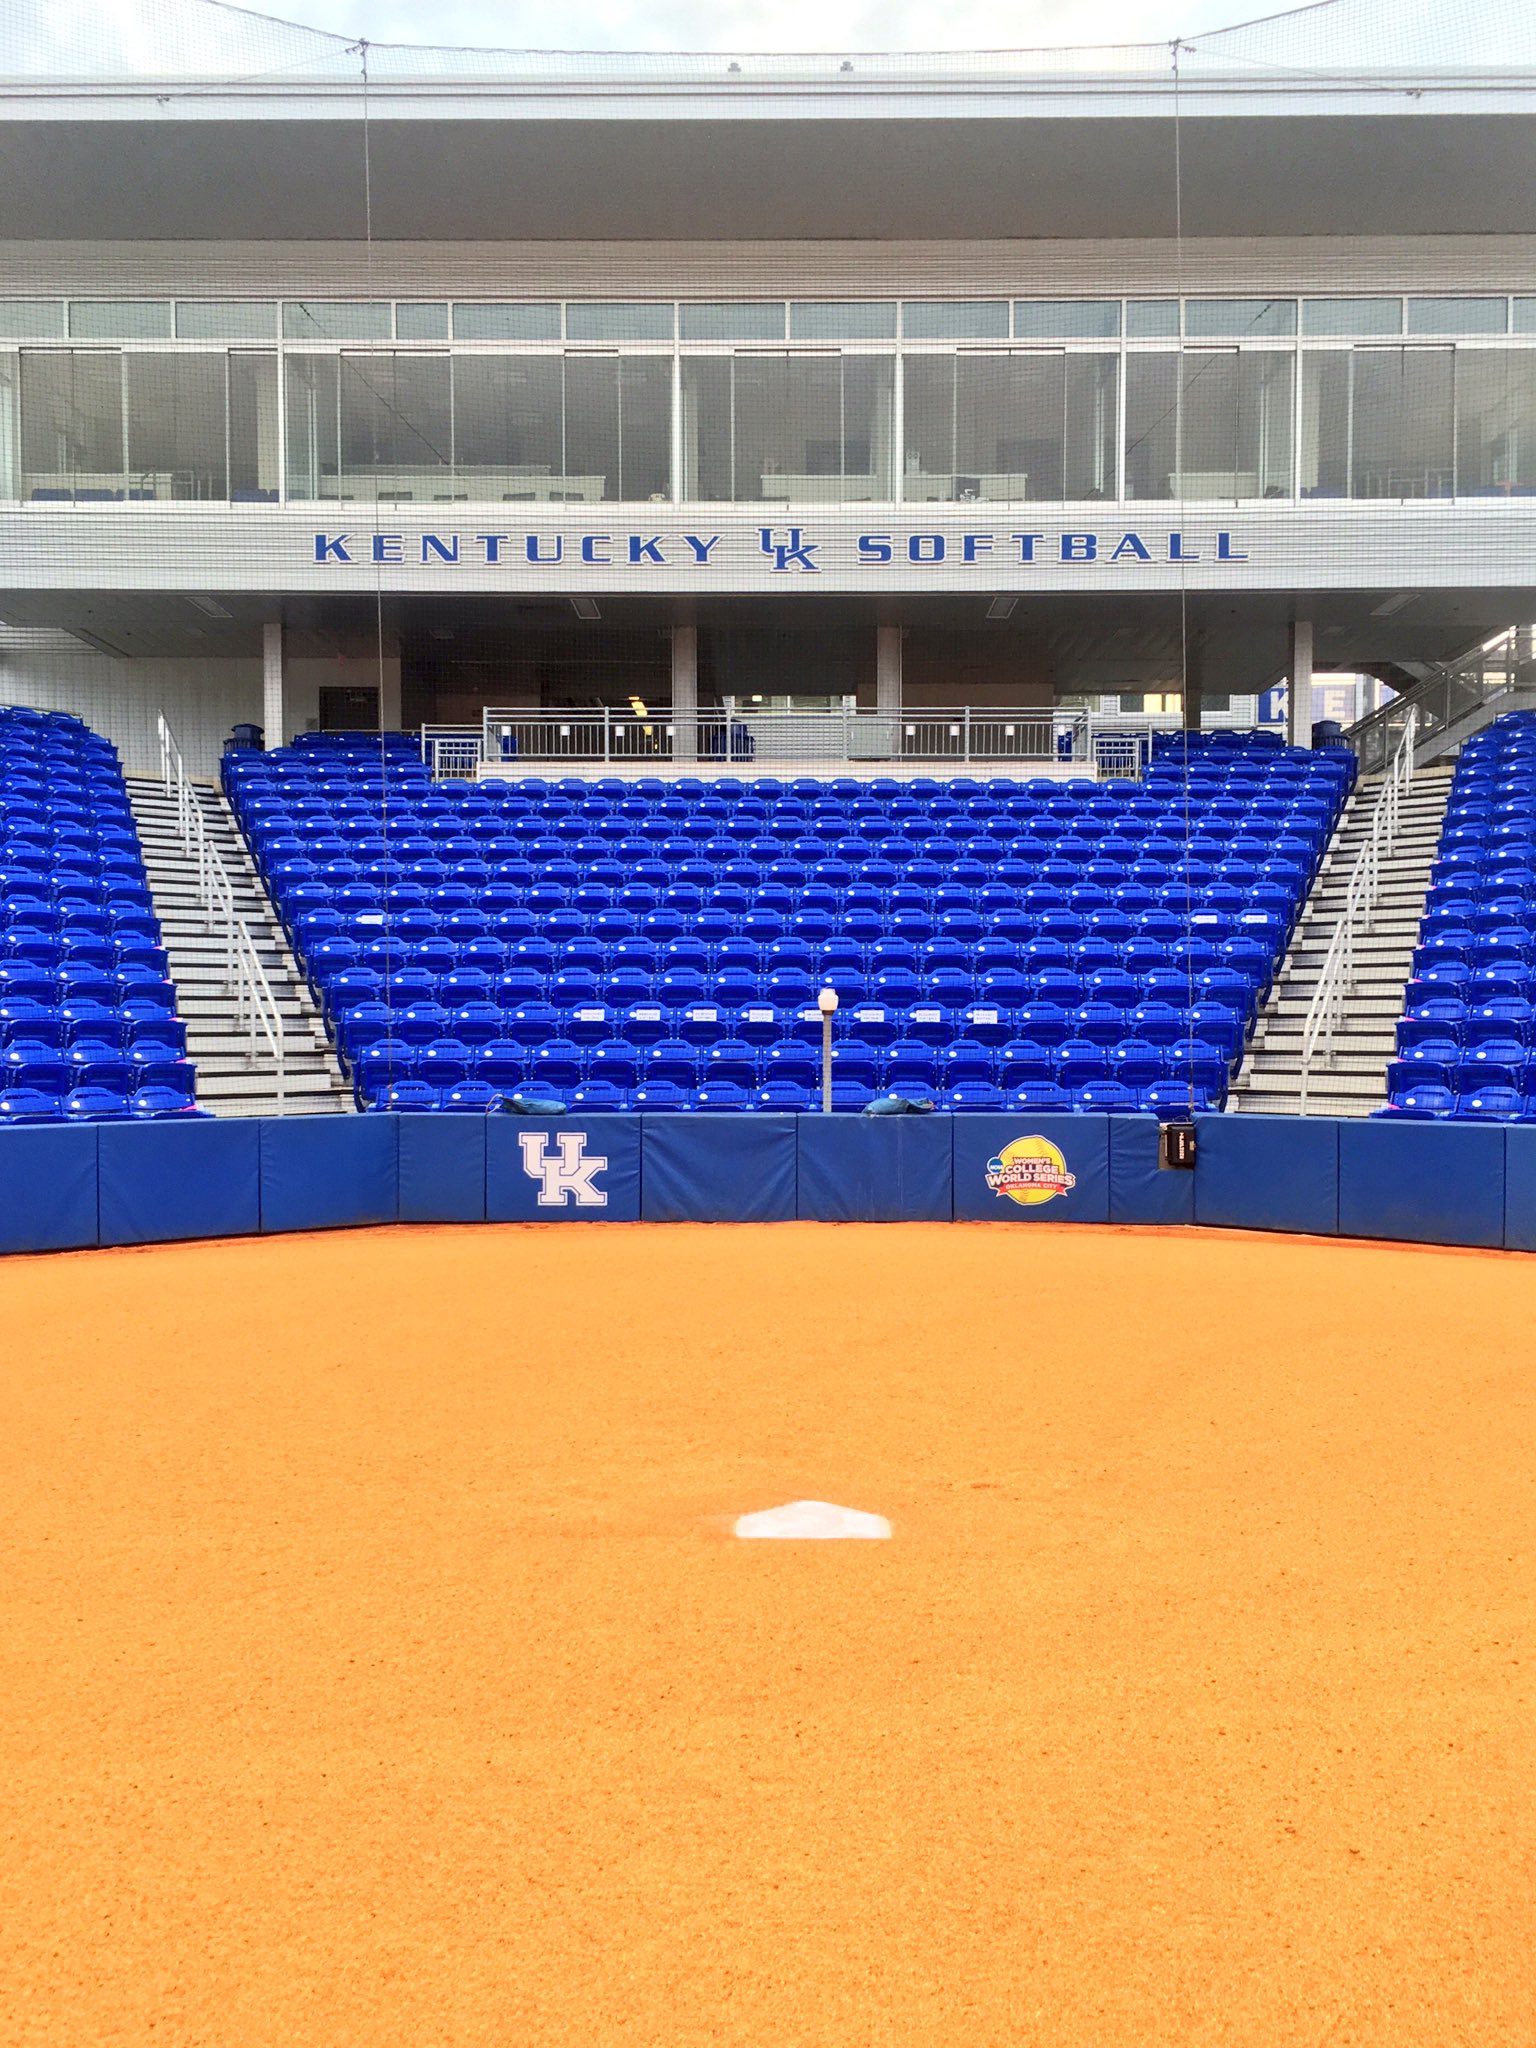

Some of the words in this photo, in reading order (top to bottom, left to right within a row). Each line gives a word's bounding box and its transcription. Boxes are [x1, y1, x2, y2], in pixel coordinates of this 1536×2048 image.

[313, 532, 724, 566] KENTUCKY
[856, 531, 1249, 566] SOFTBALL
[1014, 1157, 1051, 1165] WOMEN'S
[519, 1132, 608, 1206] UK
[1006, 1164, 1059, 1175] COLLEGE
[988, 1173, 1031, 1186] WORLD
[1033, 1173, 1074, 1186] SERIES
